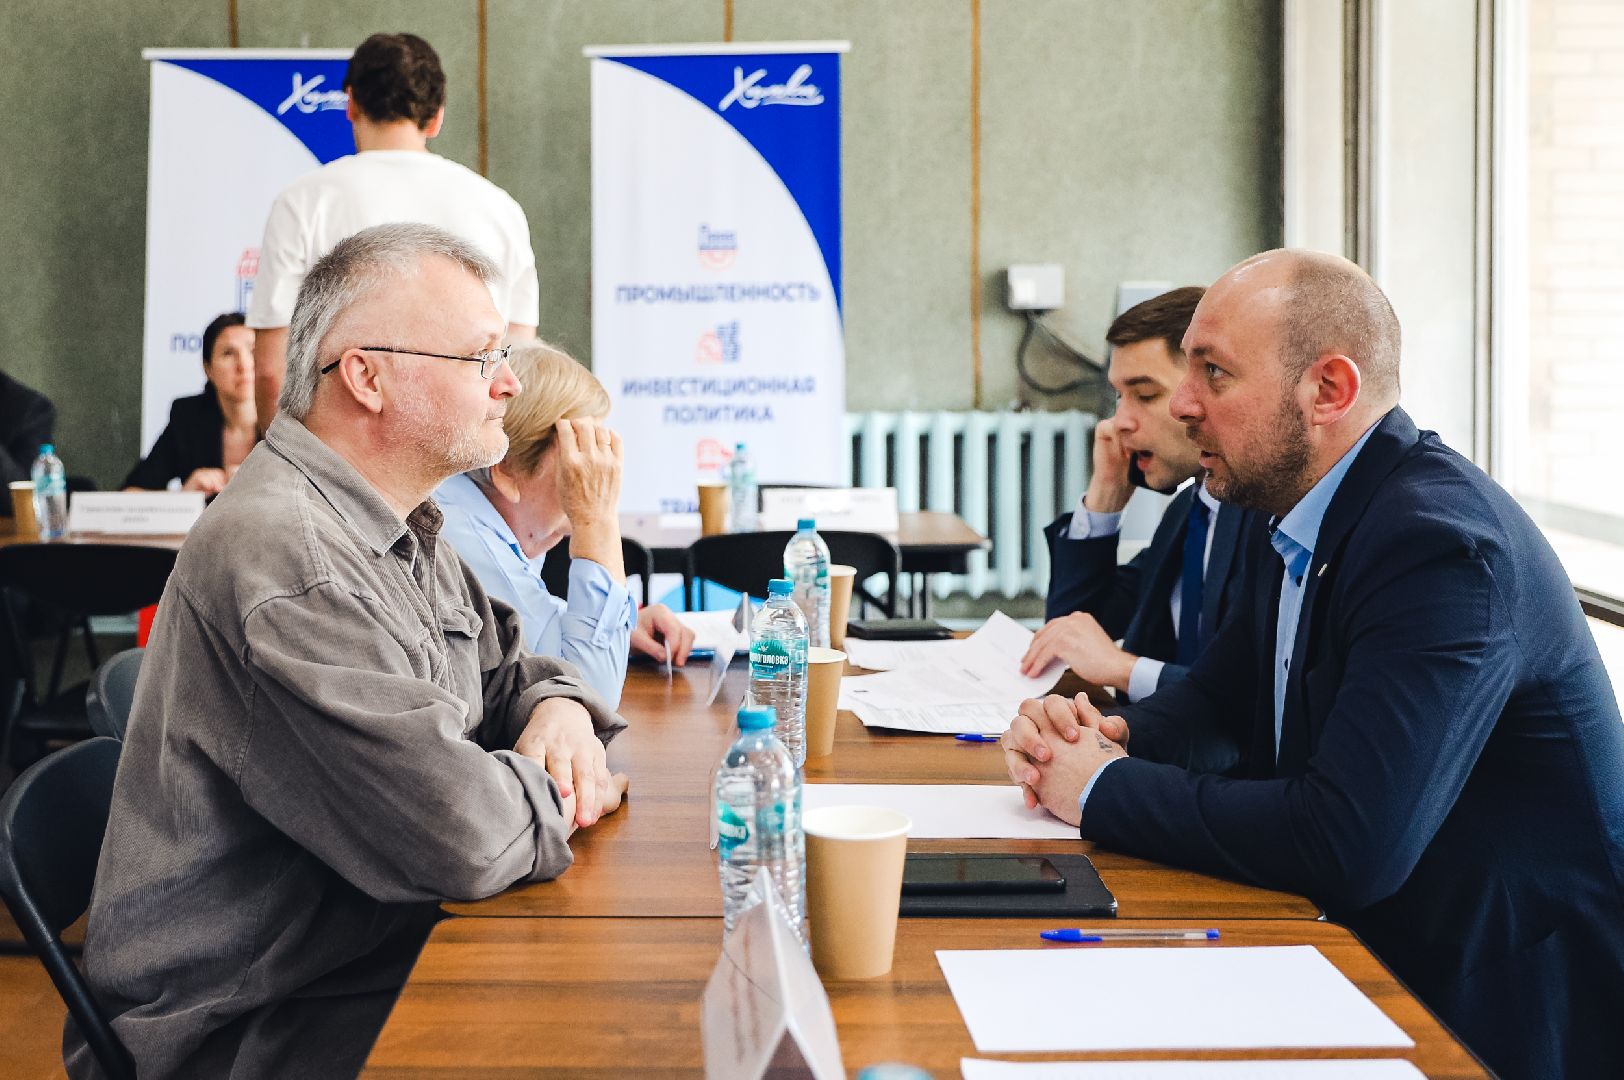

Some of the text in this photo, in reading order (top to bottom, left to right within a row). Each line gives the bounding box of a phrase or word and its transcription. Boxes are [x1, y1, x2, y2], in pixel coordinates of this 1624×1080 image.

[616, 284, 821, 304] ПРОМЫШЛЕННОСТЬ
[622, 376, 816, 396] ИНВЕСТИЦИОННАЯ
[663, 405, 773, 424] ПОЛИТИКА
